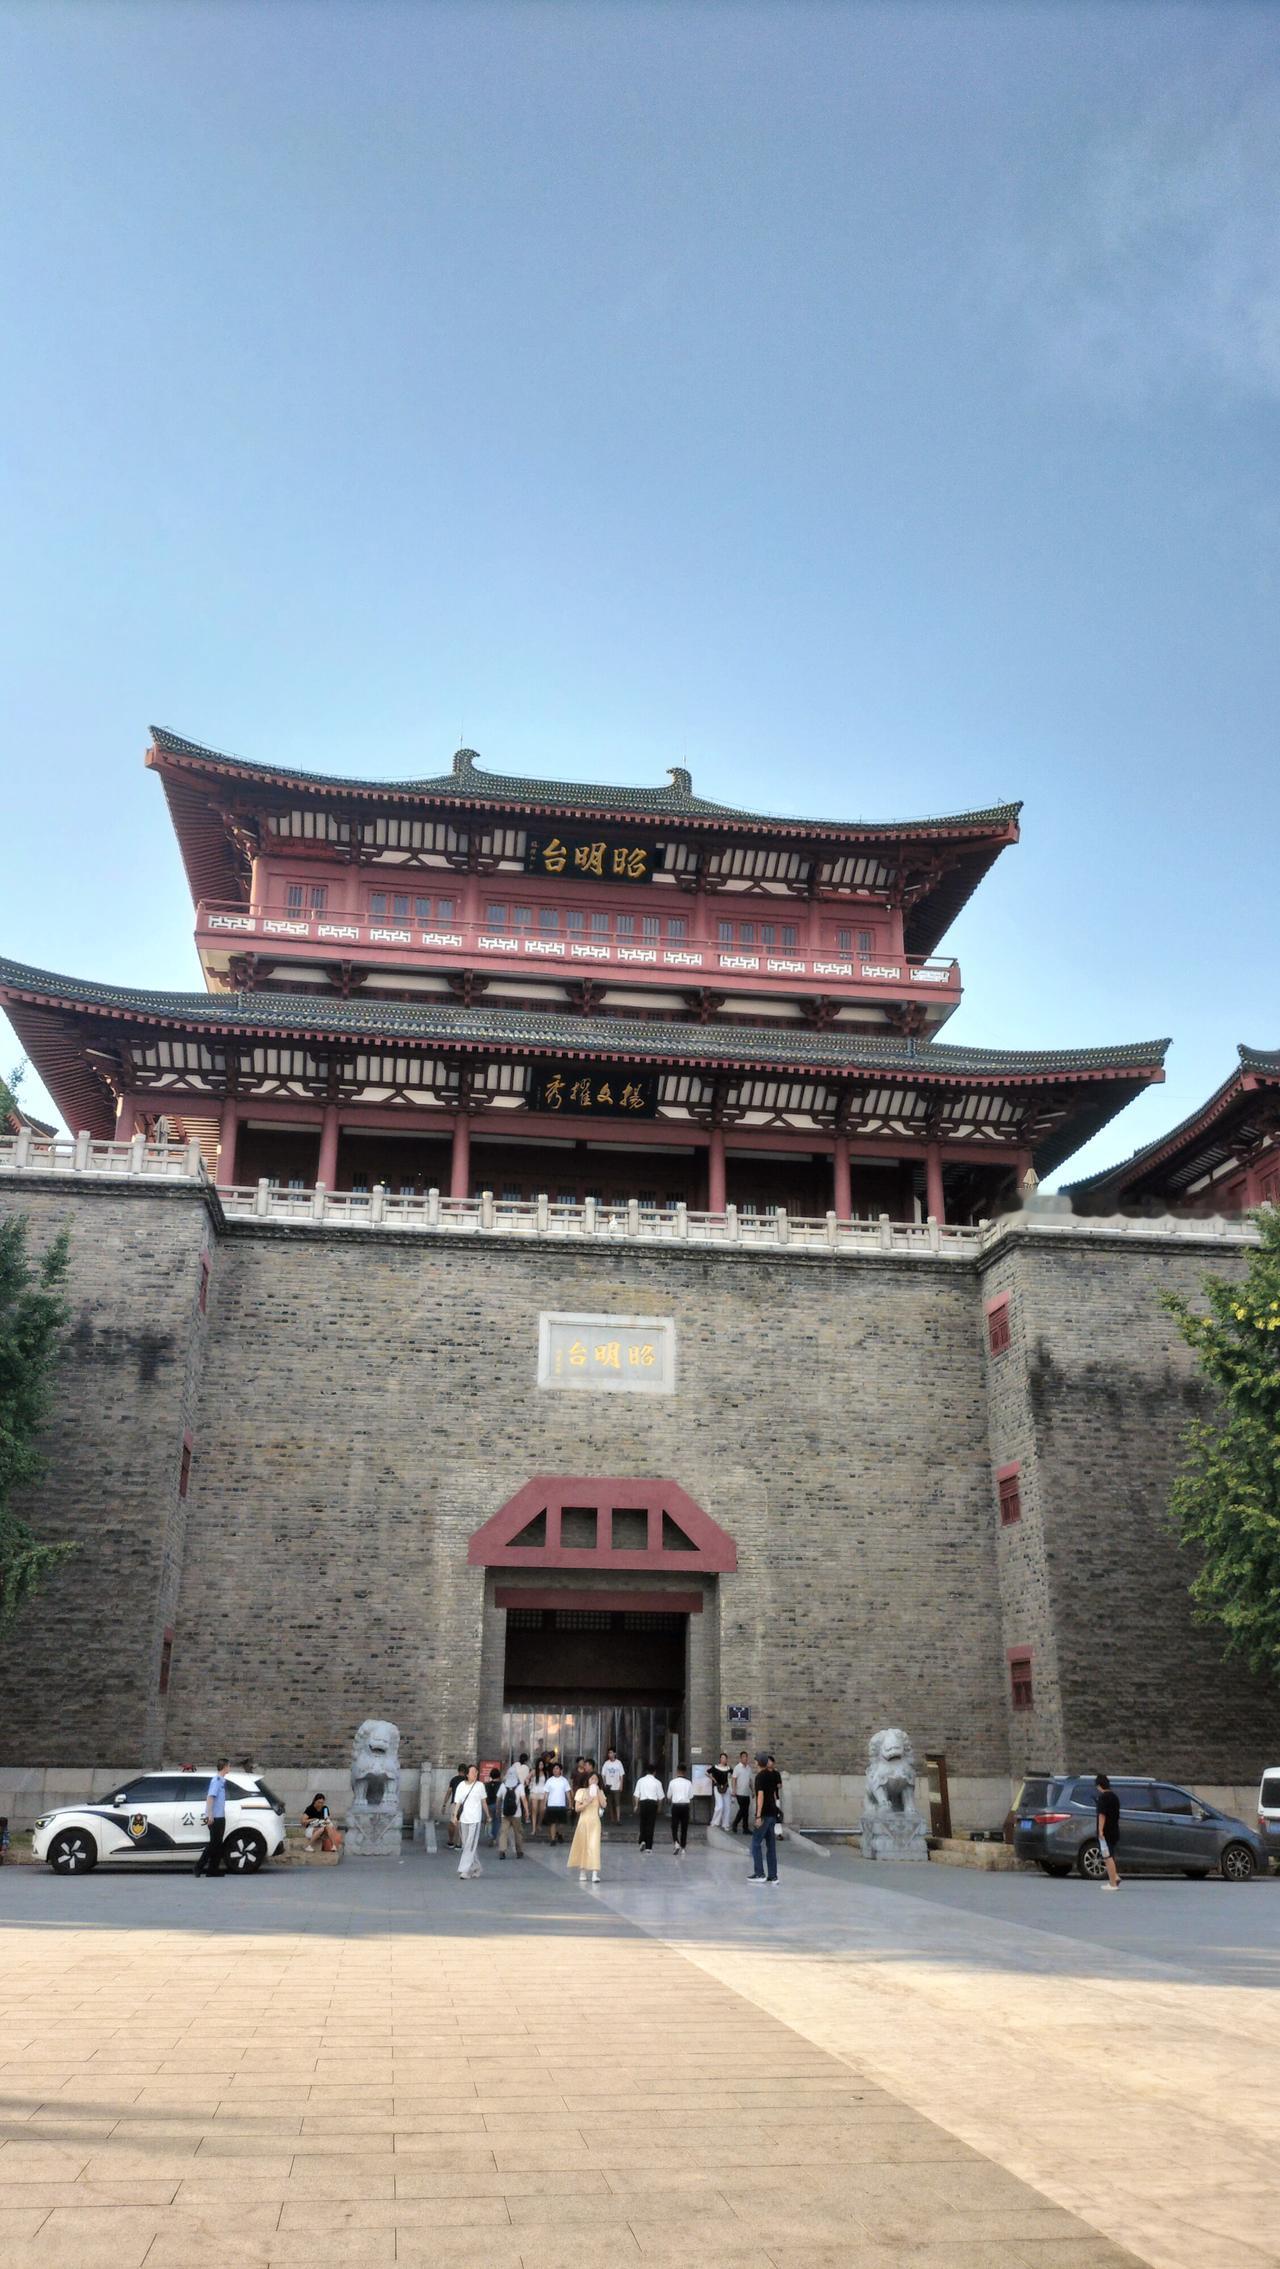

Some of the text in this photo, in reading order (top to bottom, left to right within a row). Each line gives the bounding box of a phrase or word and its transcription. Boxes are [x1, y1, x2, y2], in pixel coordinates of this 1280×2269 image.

[542, 838, 648, 878] 昭明台
[569, 1339, 657, 1369] 昭明台
